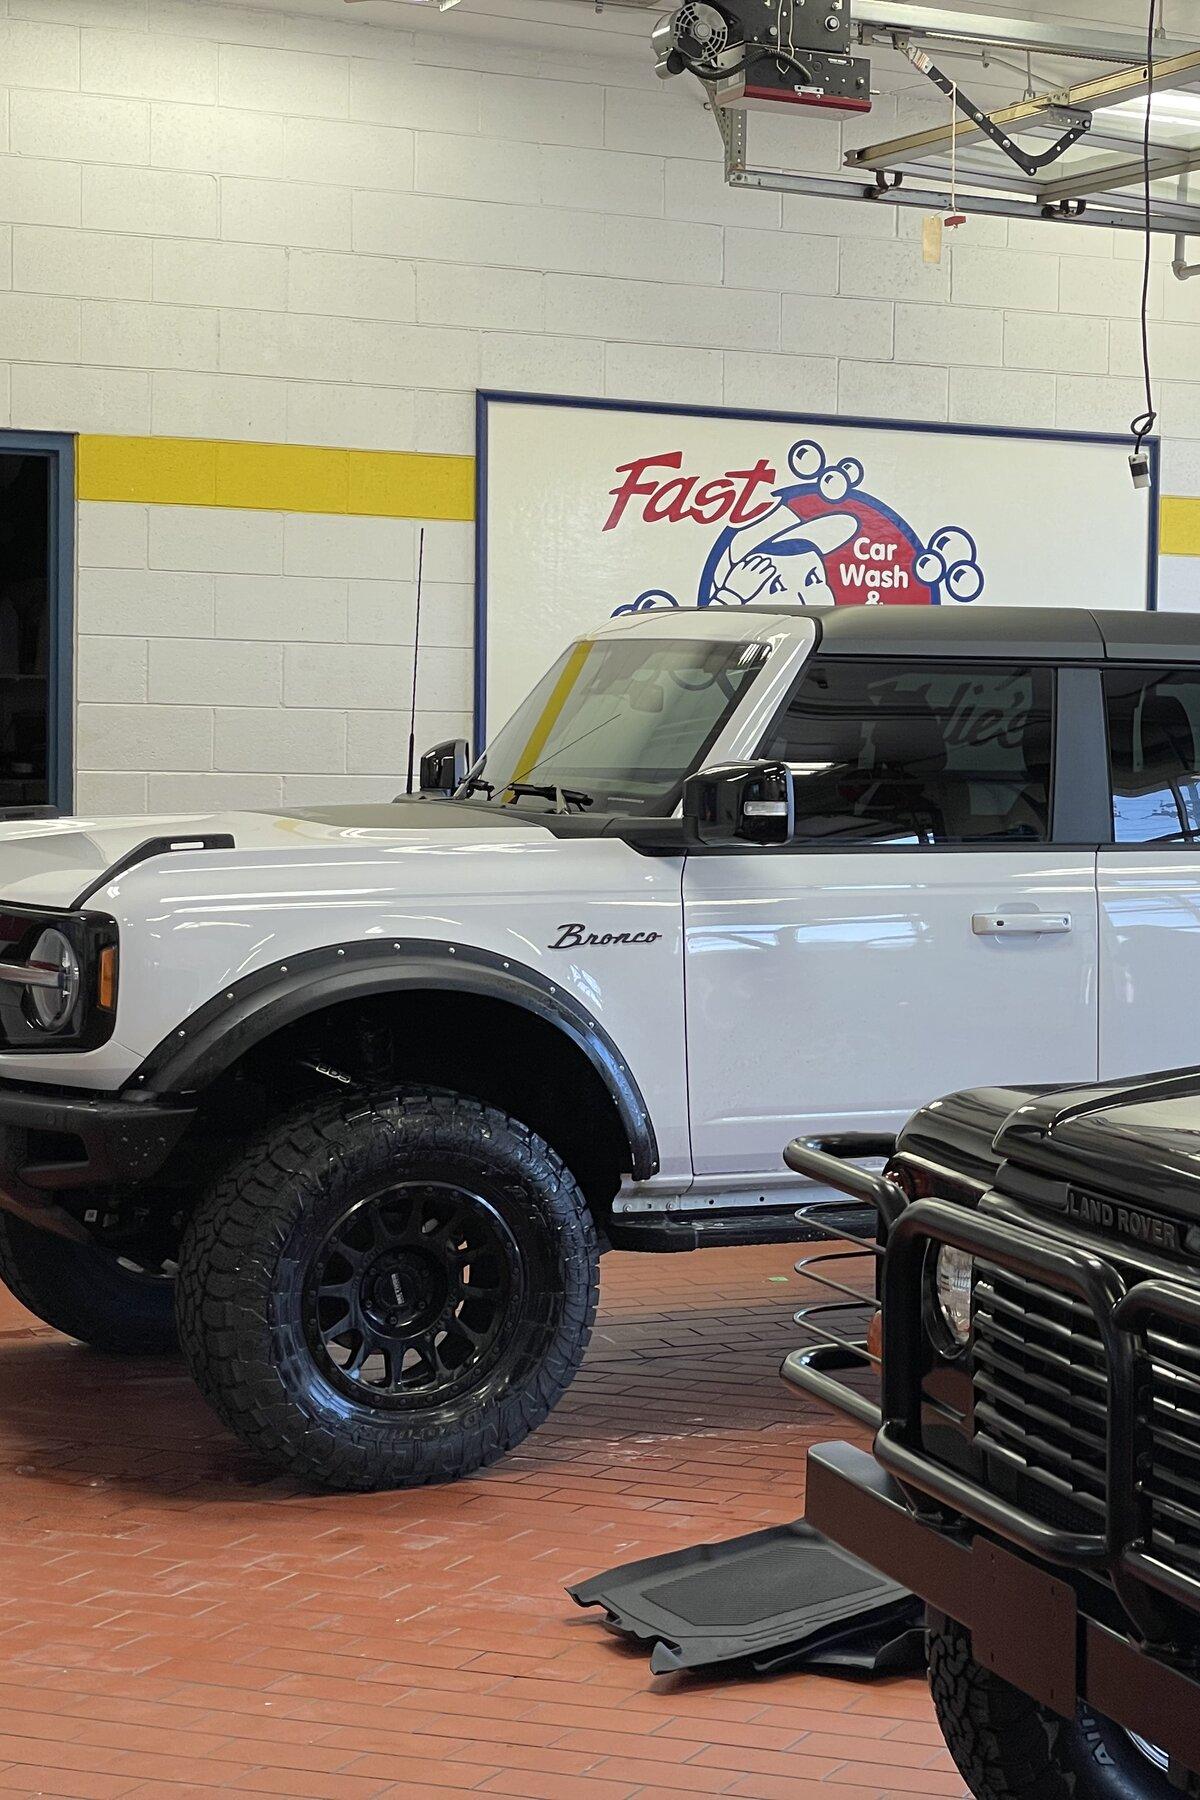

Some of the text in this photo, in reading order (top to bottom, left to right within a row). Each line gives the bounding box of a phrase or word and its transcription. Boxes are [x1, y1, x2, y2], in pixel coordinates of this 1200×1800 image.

[602, 451, 776, 532] Fast
[853, 536, 898, 561] Car
[839, 563, 909, 589] Wash
[547, 923, 663, 949] Bronco
[1069, 1192, 1176, 1248] LAND ROVER
